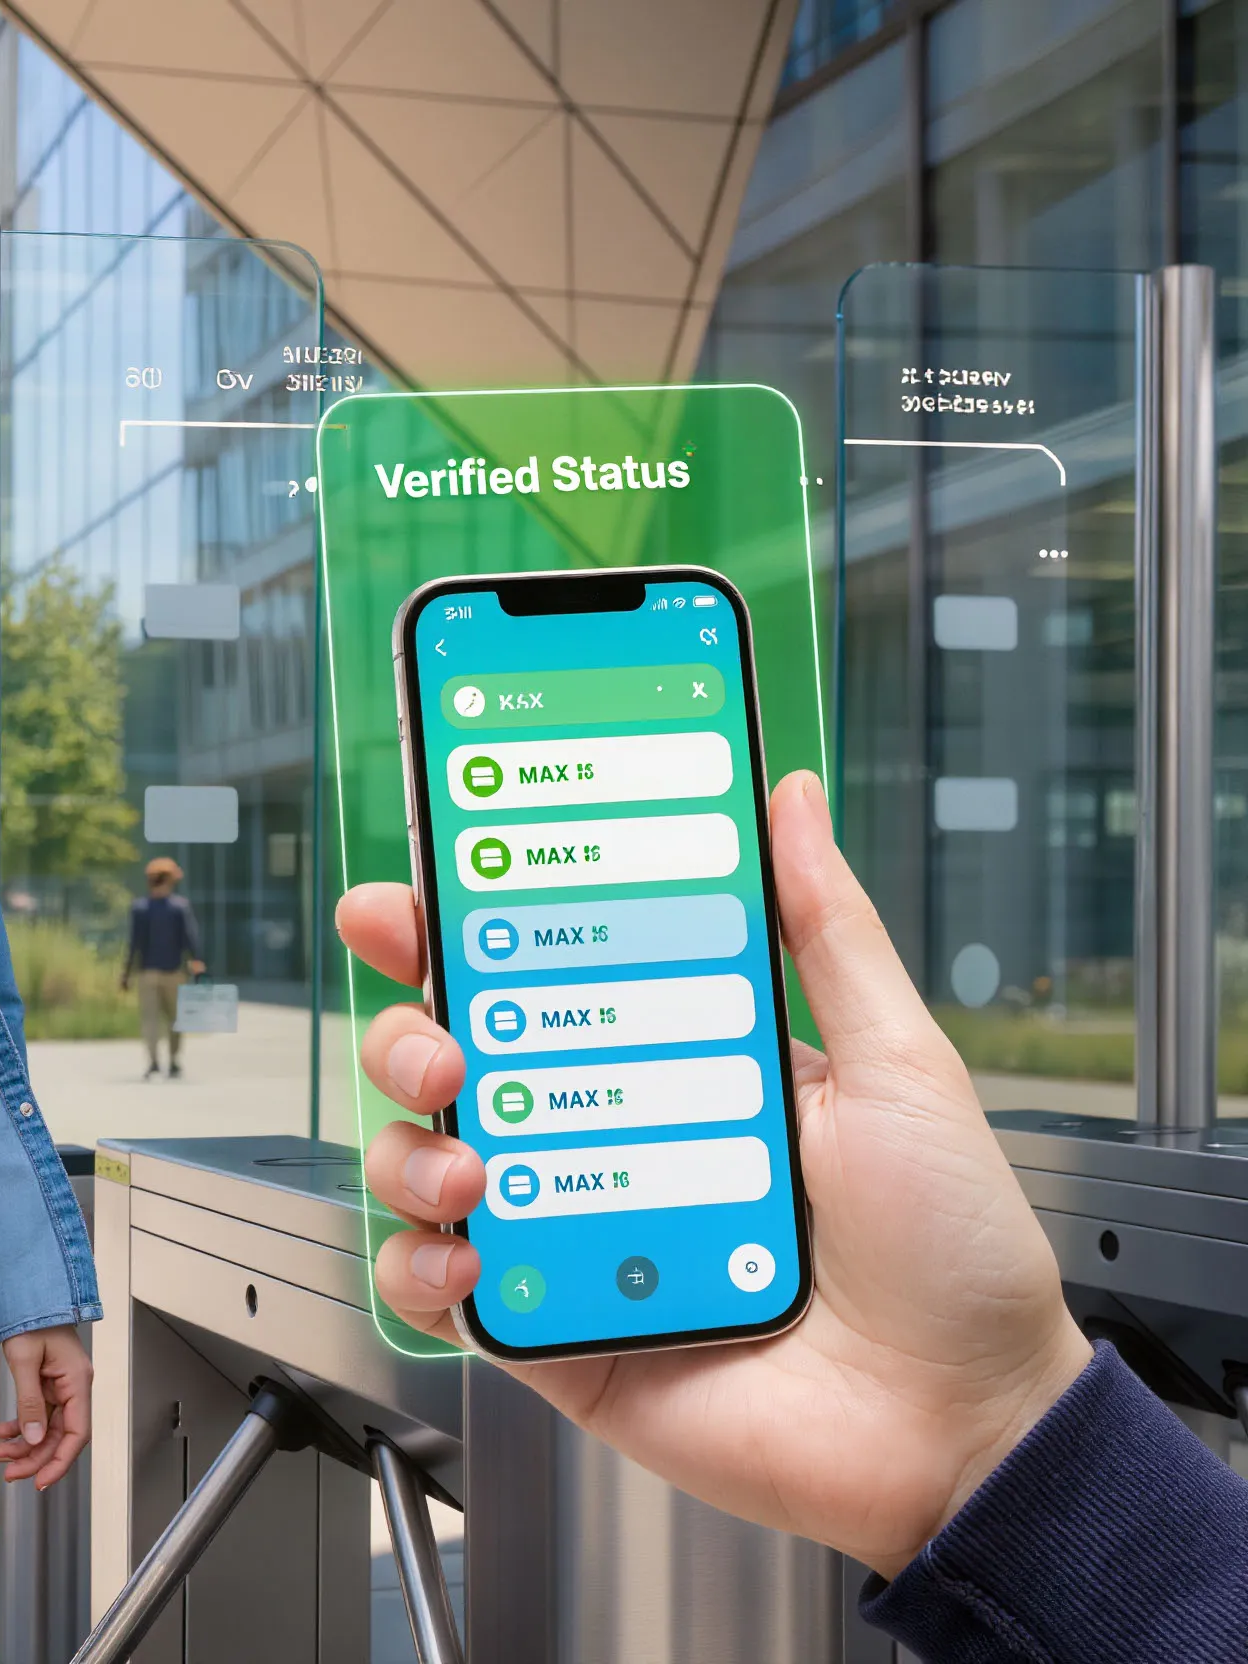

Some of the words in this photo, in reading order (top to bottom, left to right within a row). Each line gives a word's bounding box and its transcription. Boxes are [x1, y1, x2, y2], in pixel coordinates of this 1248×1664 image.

[519, 764, 570, 785] MAX
[526, 845, 578, 866] MAX
[533, 926, 585, 947] MAX
[541, 1008, 593, 1029] MAX
[548, 1089, 600, 1110] MAX
[554, 1172, 605, 1194] MAX
